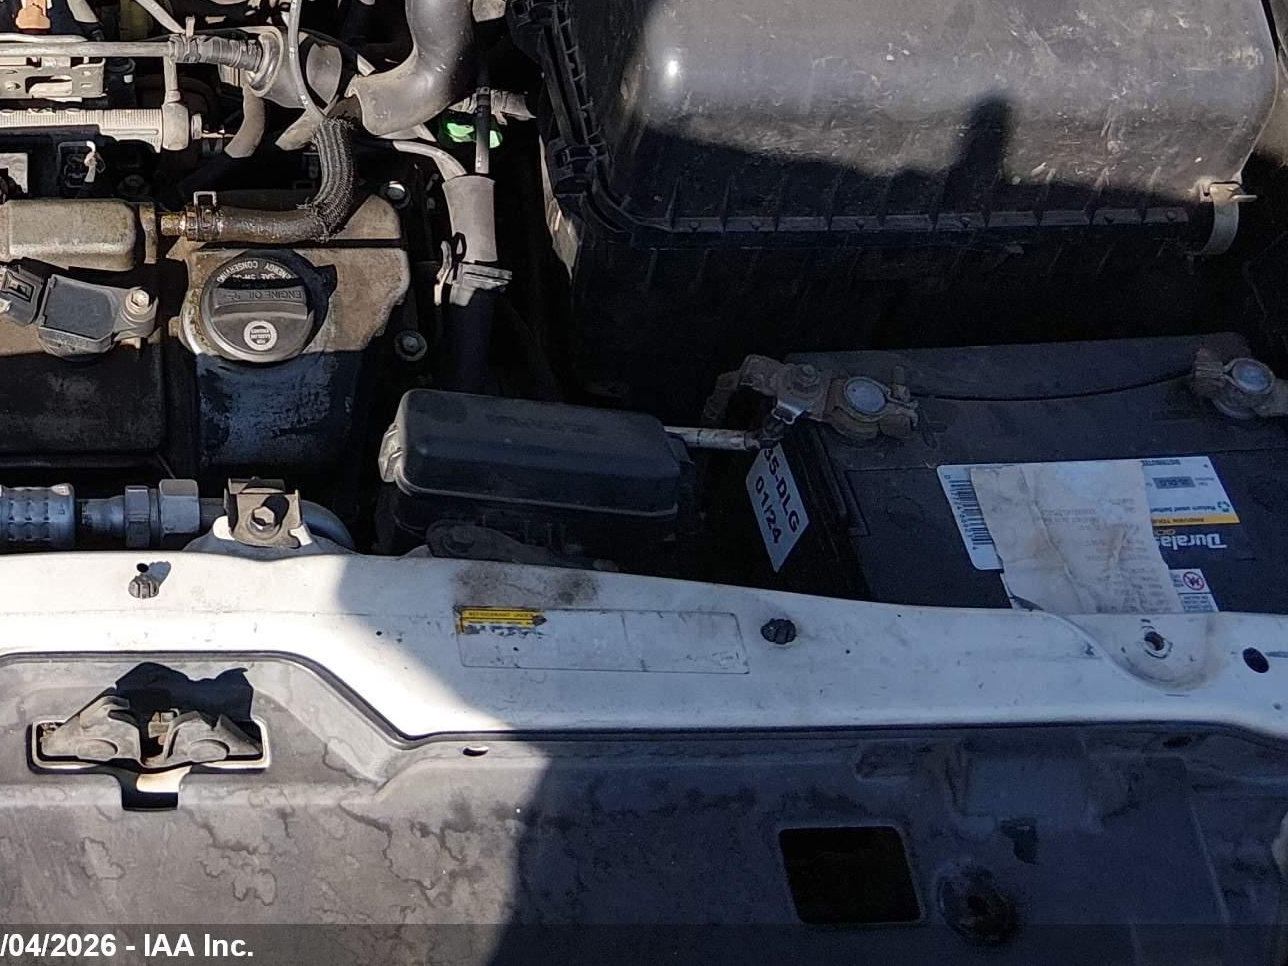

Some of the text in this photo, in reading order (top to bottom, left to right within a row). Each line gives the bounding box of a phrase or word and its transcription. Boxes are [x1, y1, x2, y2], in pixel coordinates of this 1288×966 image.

[216, 259, 293, 284] ENERGY CONSERVING
[264, 290, 303, 299] ENGINE
[755, 475, 782, 544] 01/24
